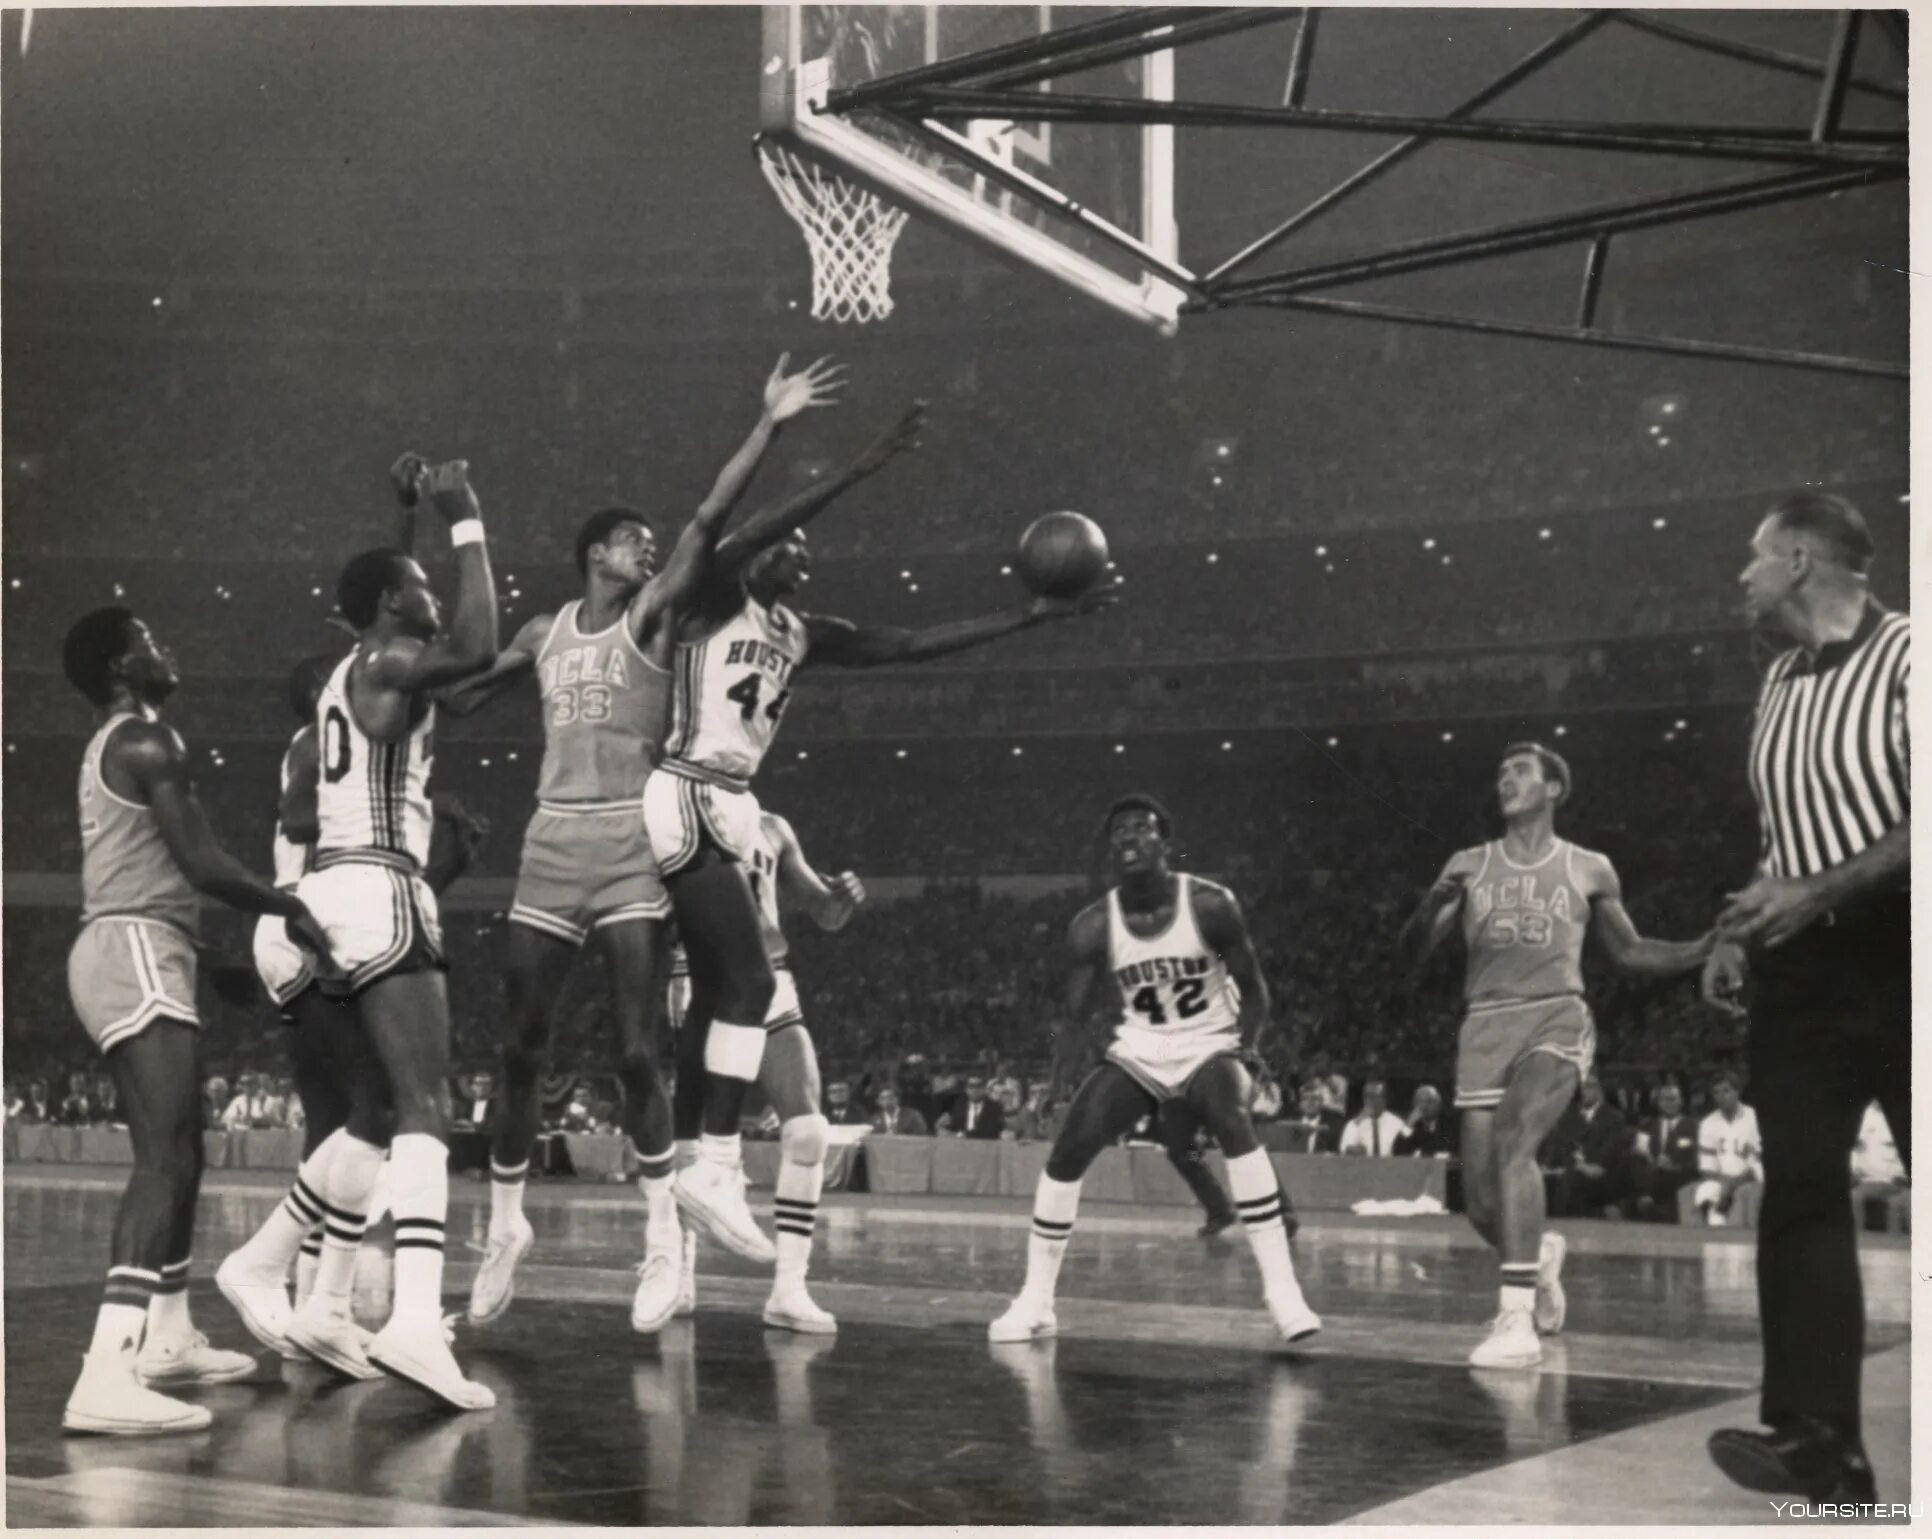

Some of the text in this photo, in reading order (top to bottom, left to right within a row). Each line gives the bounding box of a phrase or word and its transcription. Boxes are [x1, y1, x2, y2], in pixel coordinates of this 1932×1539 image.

[551, 685, 612, 726] 33
[1474, 876, 1571, 923] UCLA
[1488, 911, 1553, 949] 53
[1117, 956, 1208, 988] HOUSTON
[1132, 978, 1209, 1024] 42
